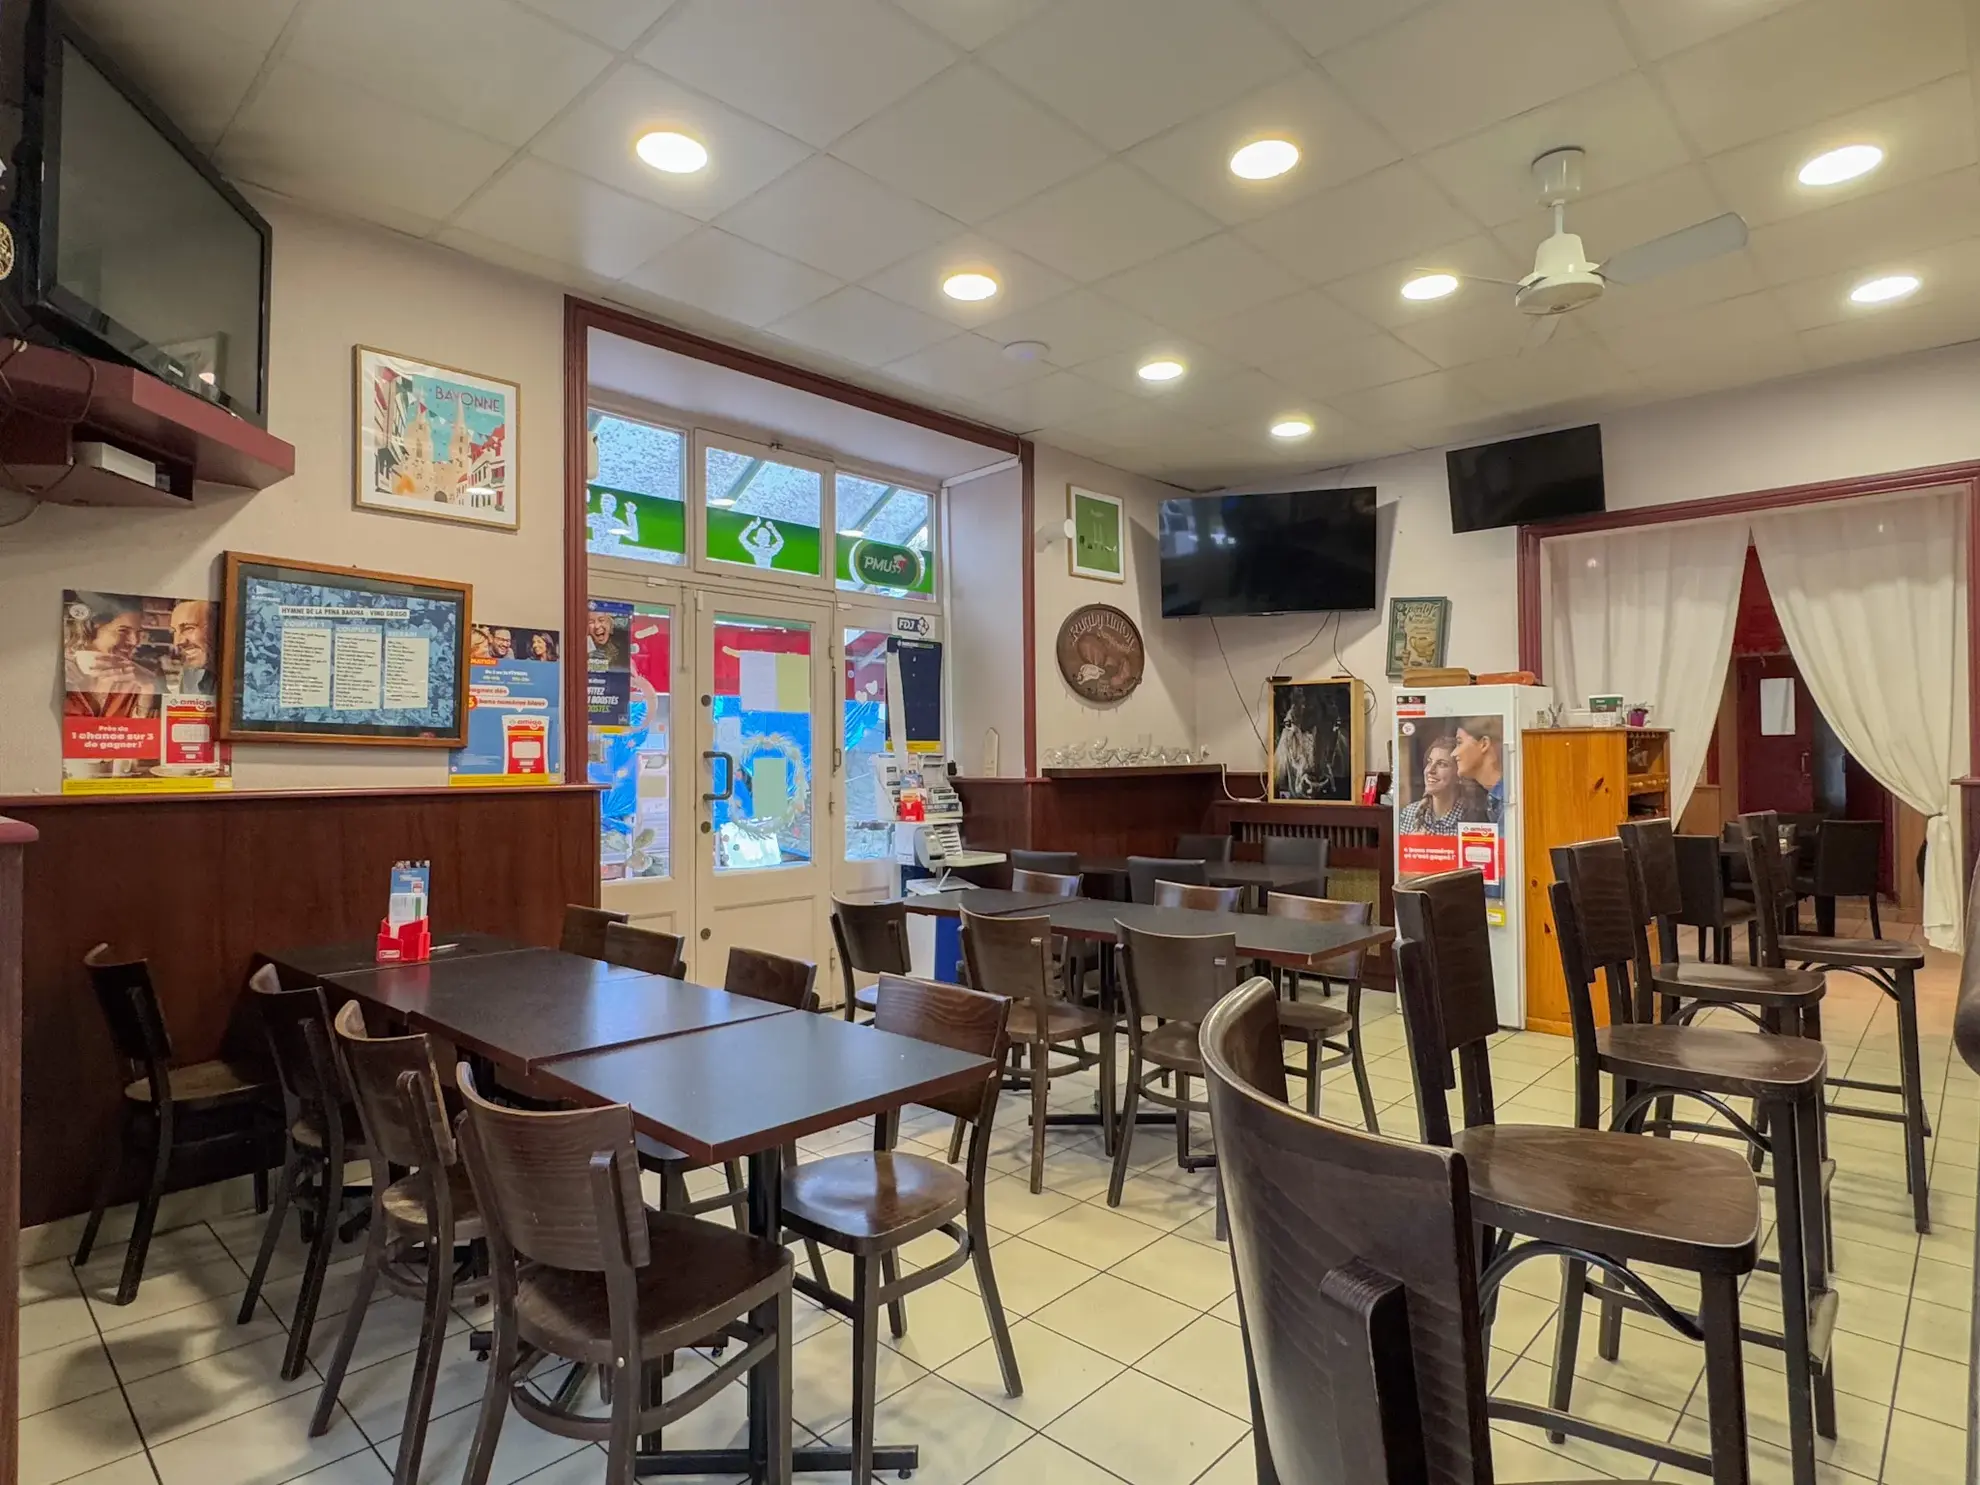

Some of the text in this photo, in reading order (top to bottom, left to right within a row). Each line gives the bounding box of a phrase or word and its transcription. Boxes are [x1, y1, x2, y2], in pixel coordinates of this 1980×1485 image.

[435, 386, 500, 412] BAYONNE
[864, 555, 893, 573] PMU
[898, 619, 916, 630] FDJ
[180, 698, 212, 709] amigo
[517, 719, 543, 728] amigo
[78, 732, 125, 740] chance
[99, 742, 138, 750] gagner
[1470, 825, 1493, 835] amigo
